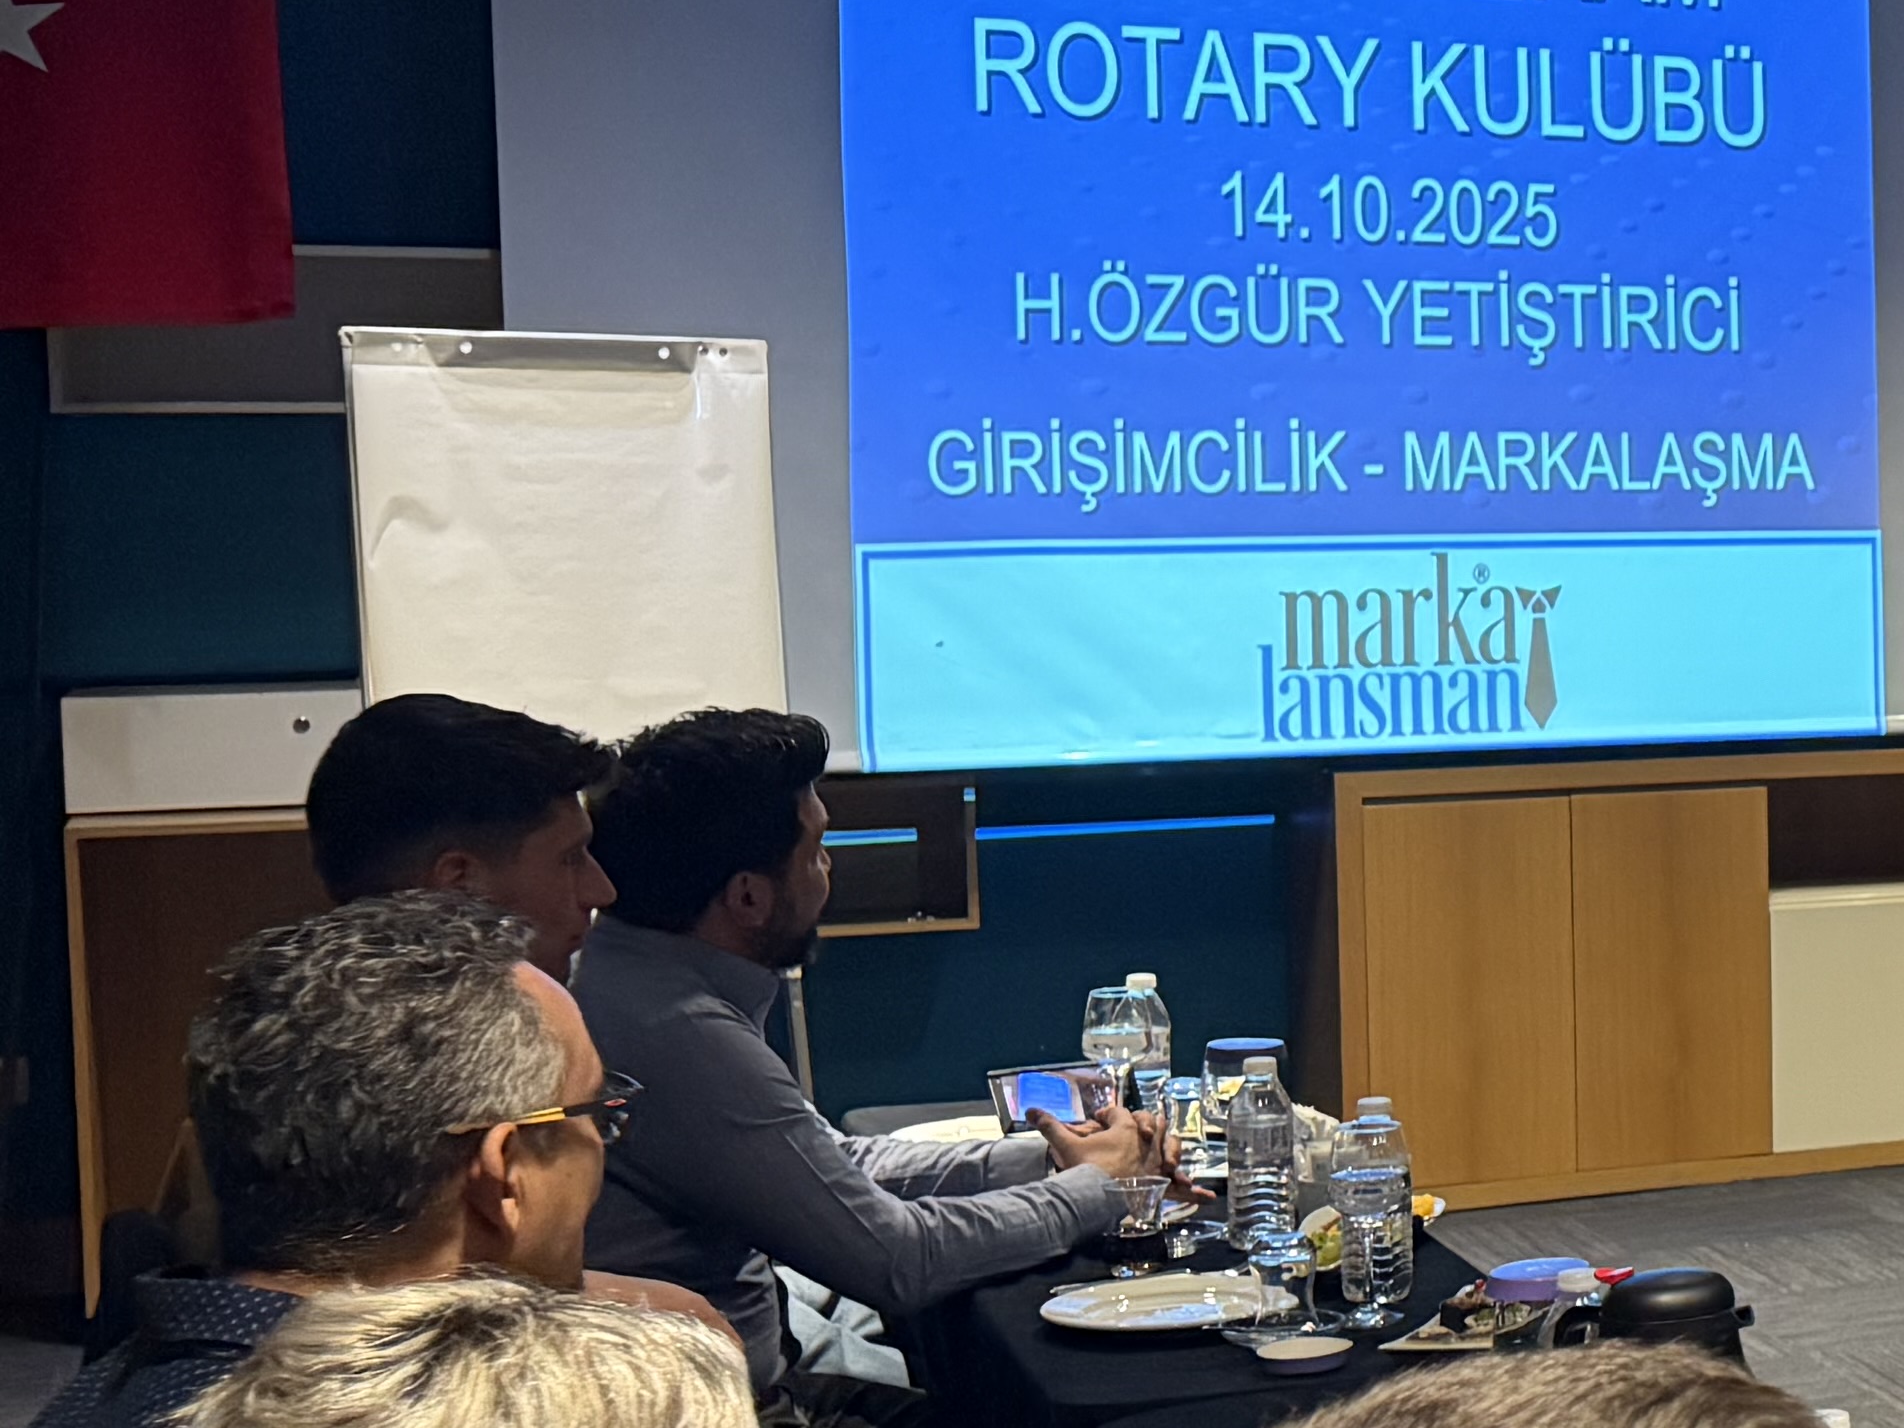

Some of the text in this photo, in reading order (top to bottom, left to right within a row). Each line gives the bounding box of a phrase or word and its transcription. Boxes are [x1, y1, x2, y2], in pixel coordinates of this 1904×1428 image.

[972, 16, 1767, 149] ROTARY KULÜBÜ
[1220, 169, 1559, 248] 14.10.2025
[1013, 260, 1743, 367] H.ÖZGÜR YETİŞTİRİCİ
[927, 417, 1349, 513] GİRİŞİMCİLİK
[1403, 430, 1816, 508] MARKALAŞMA
[1278, 551, 1521, 672] marka
[1256, 643, 1526, 743] lansman
